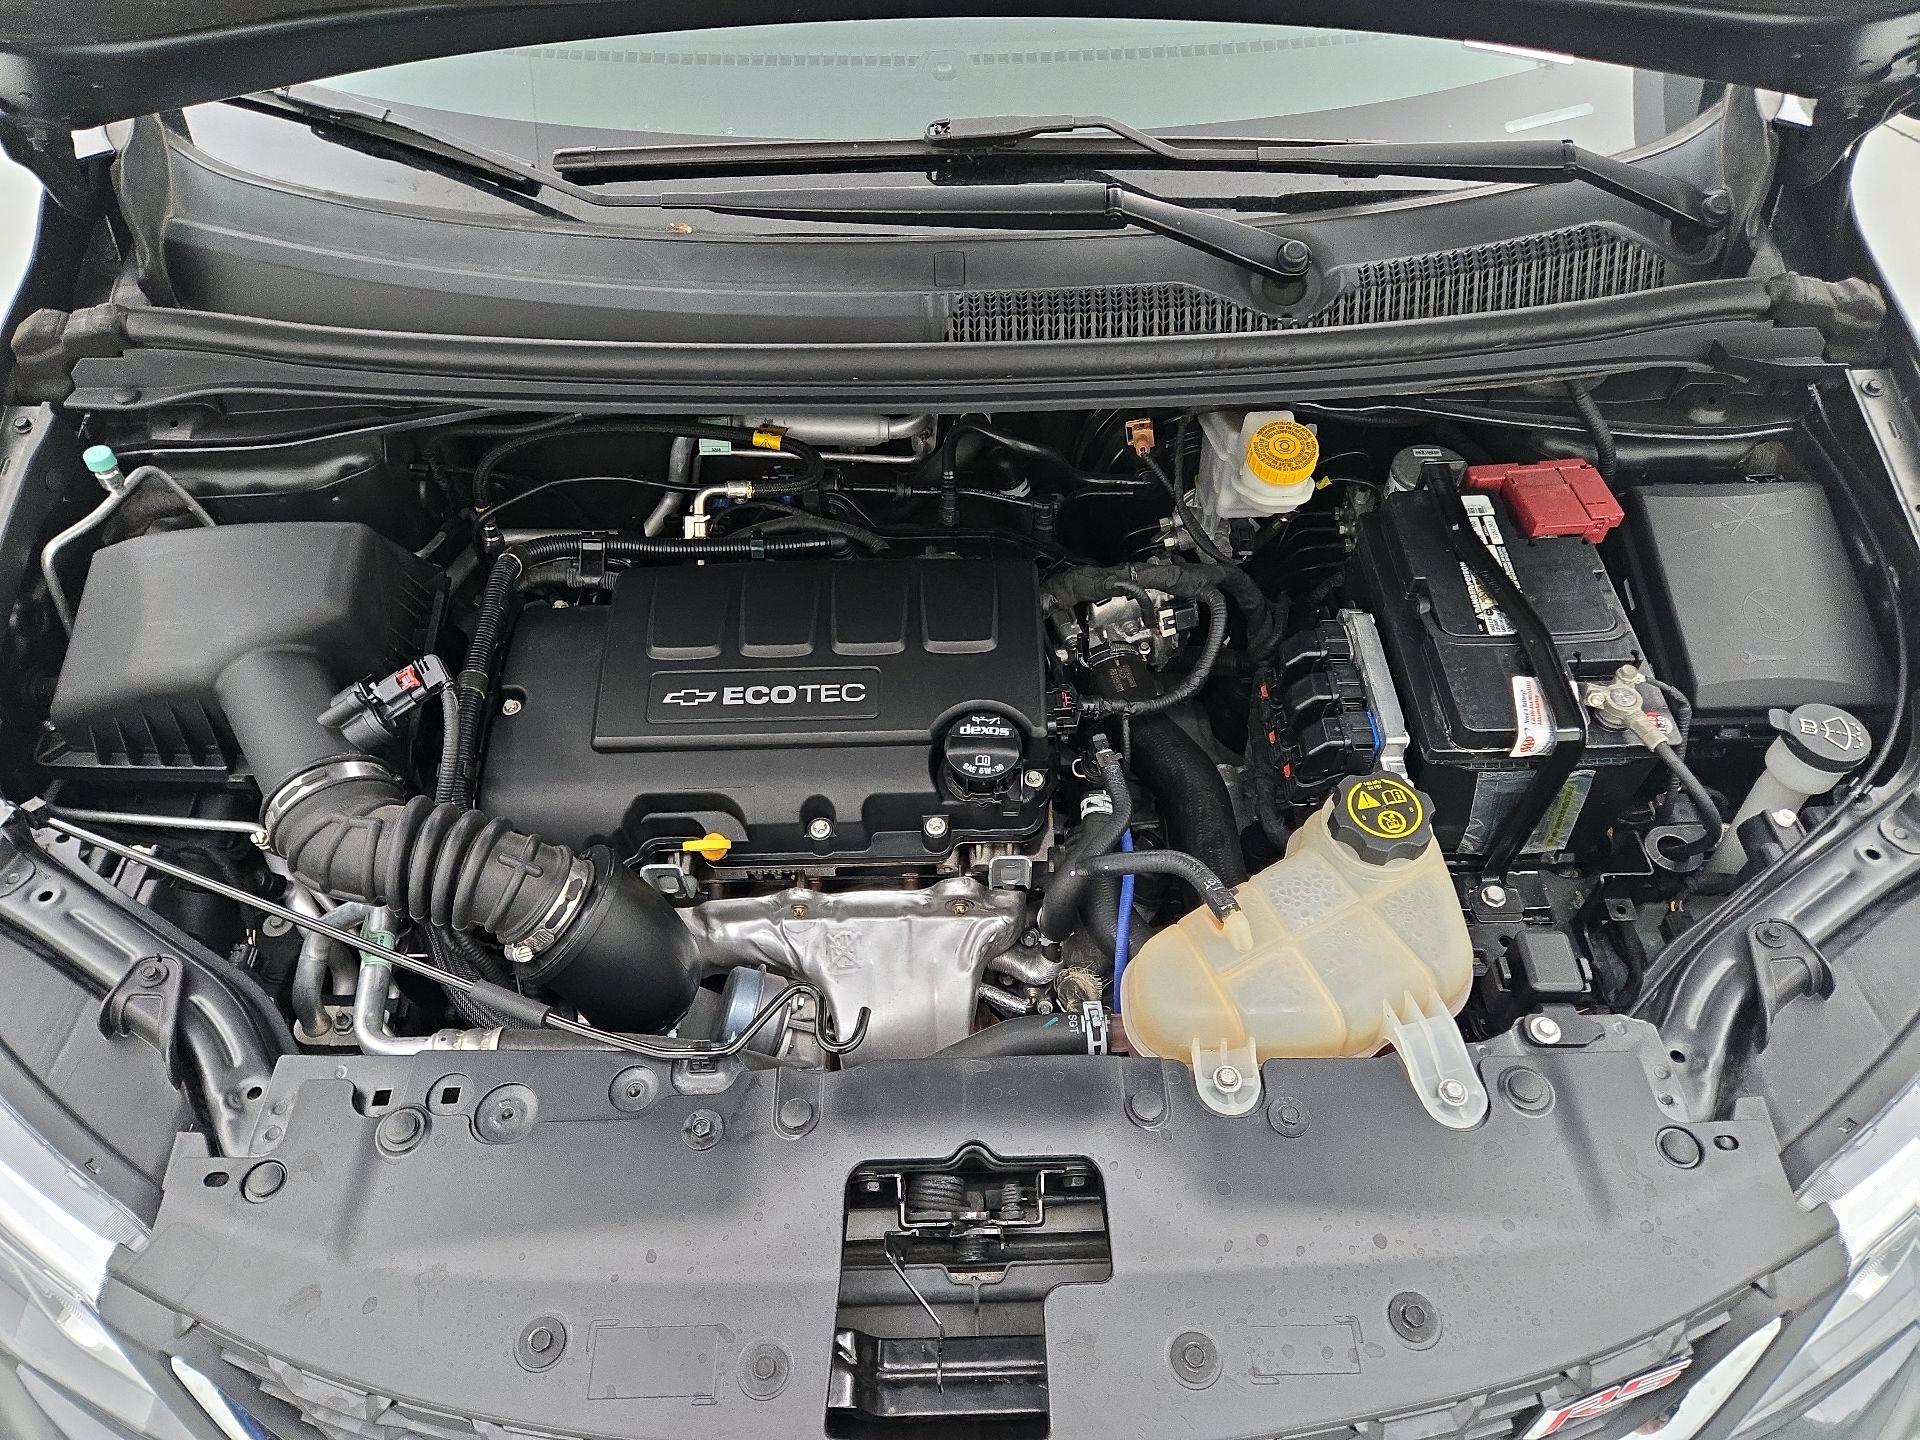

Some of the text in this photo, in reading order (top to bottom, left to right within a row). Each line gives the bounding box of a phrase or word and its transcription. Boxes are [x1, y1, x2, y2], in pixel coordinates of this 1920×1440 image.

[722, 683, 866, 705] ECOTEC
[960, 724, 1011, 736] dexos
[962, 763, 977, 773] SAE
[1068, 1014, 1079, 1034] SGT
